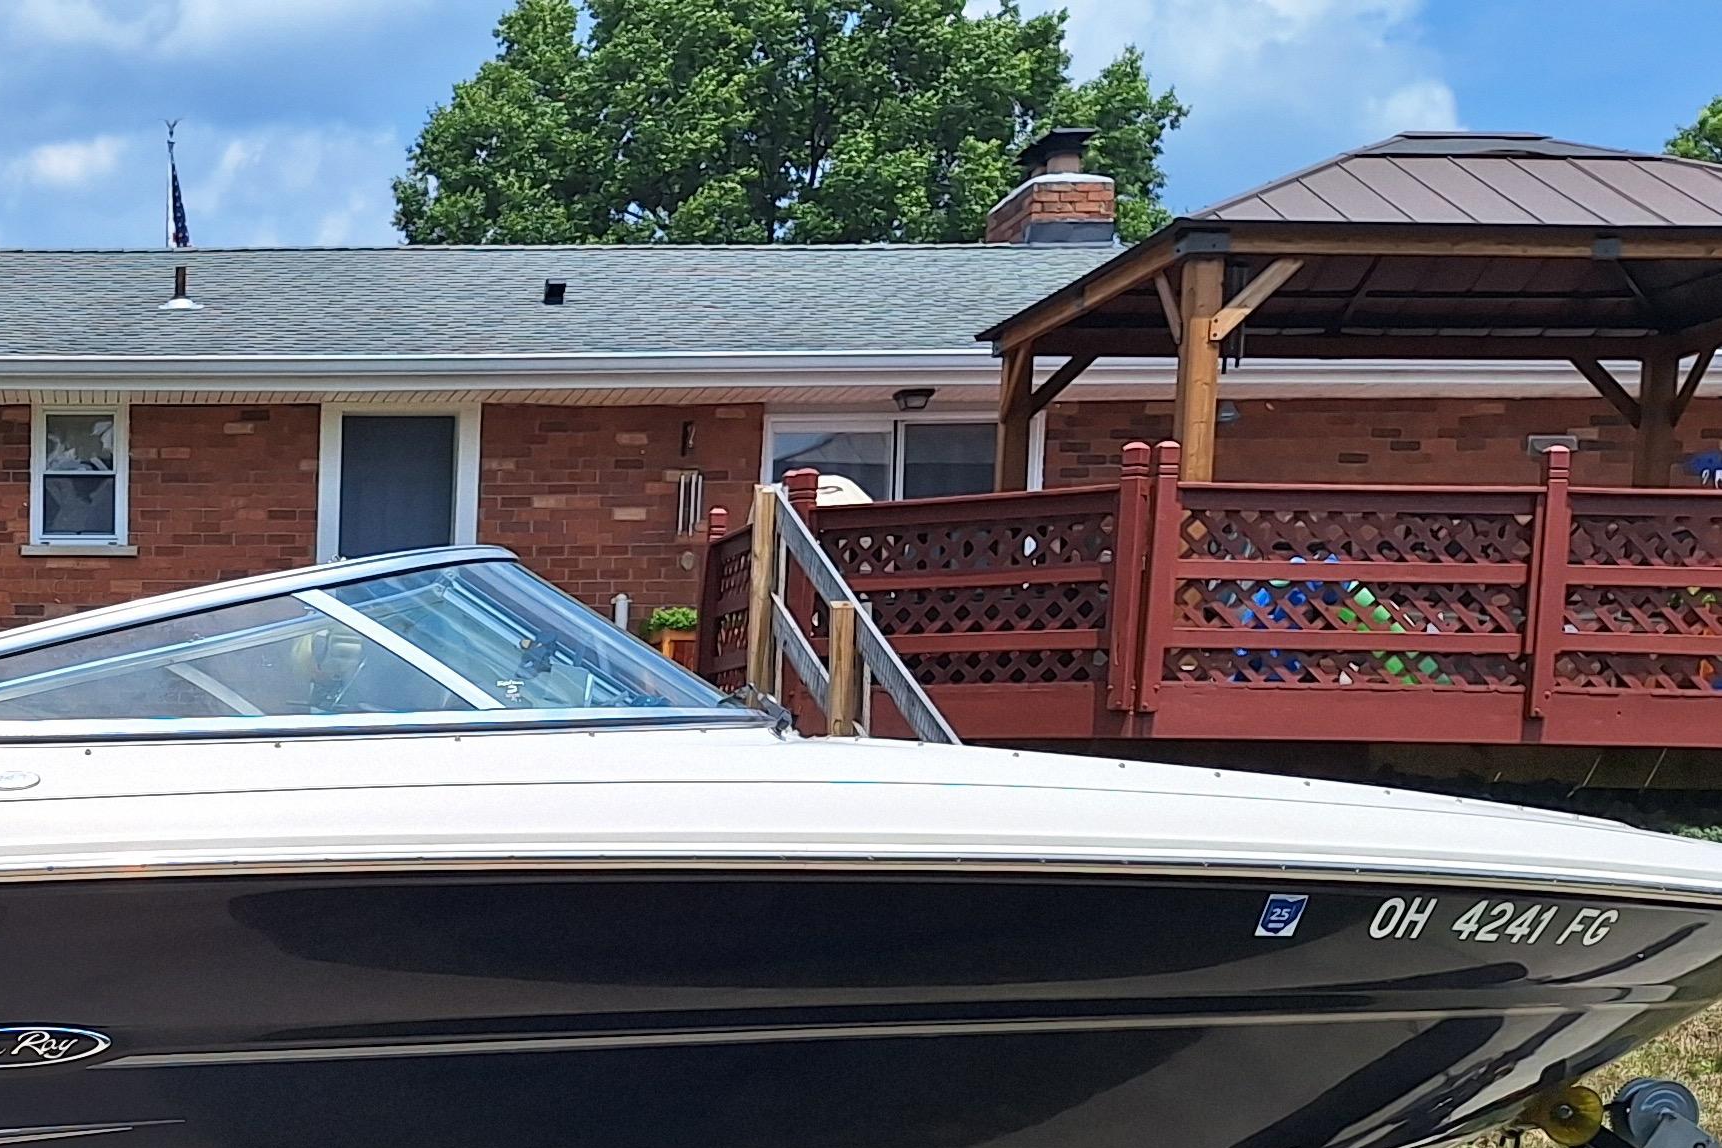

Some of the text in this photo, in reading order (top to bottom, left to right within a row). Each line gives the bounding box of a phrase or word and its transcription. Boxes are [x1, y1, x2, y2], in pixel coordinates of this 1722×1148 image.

[1269, 908, 1291, 920] 25
[1369, 897, 1619, 946] OH 4241 FG
[11, 1030, 78, 1059] Ray
